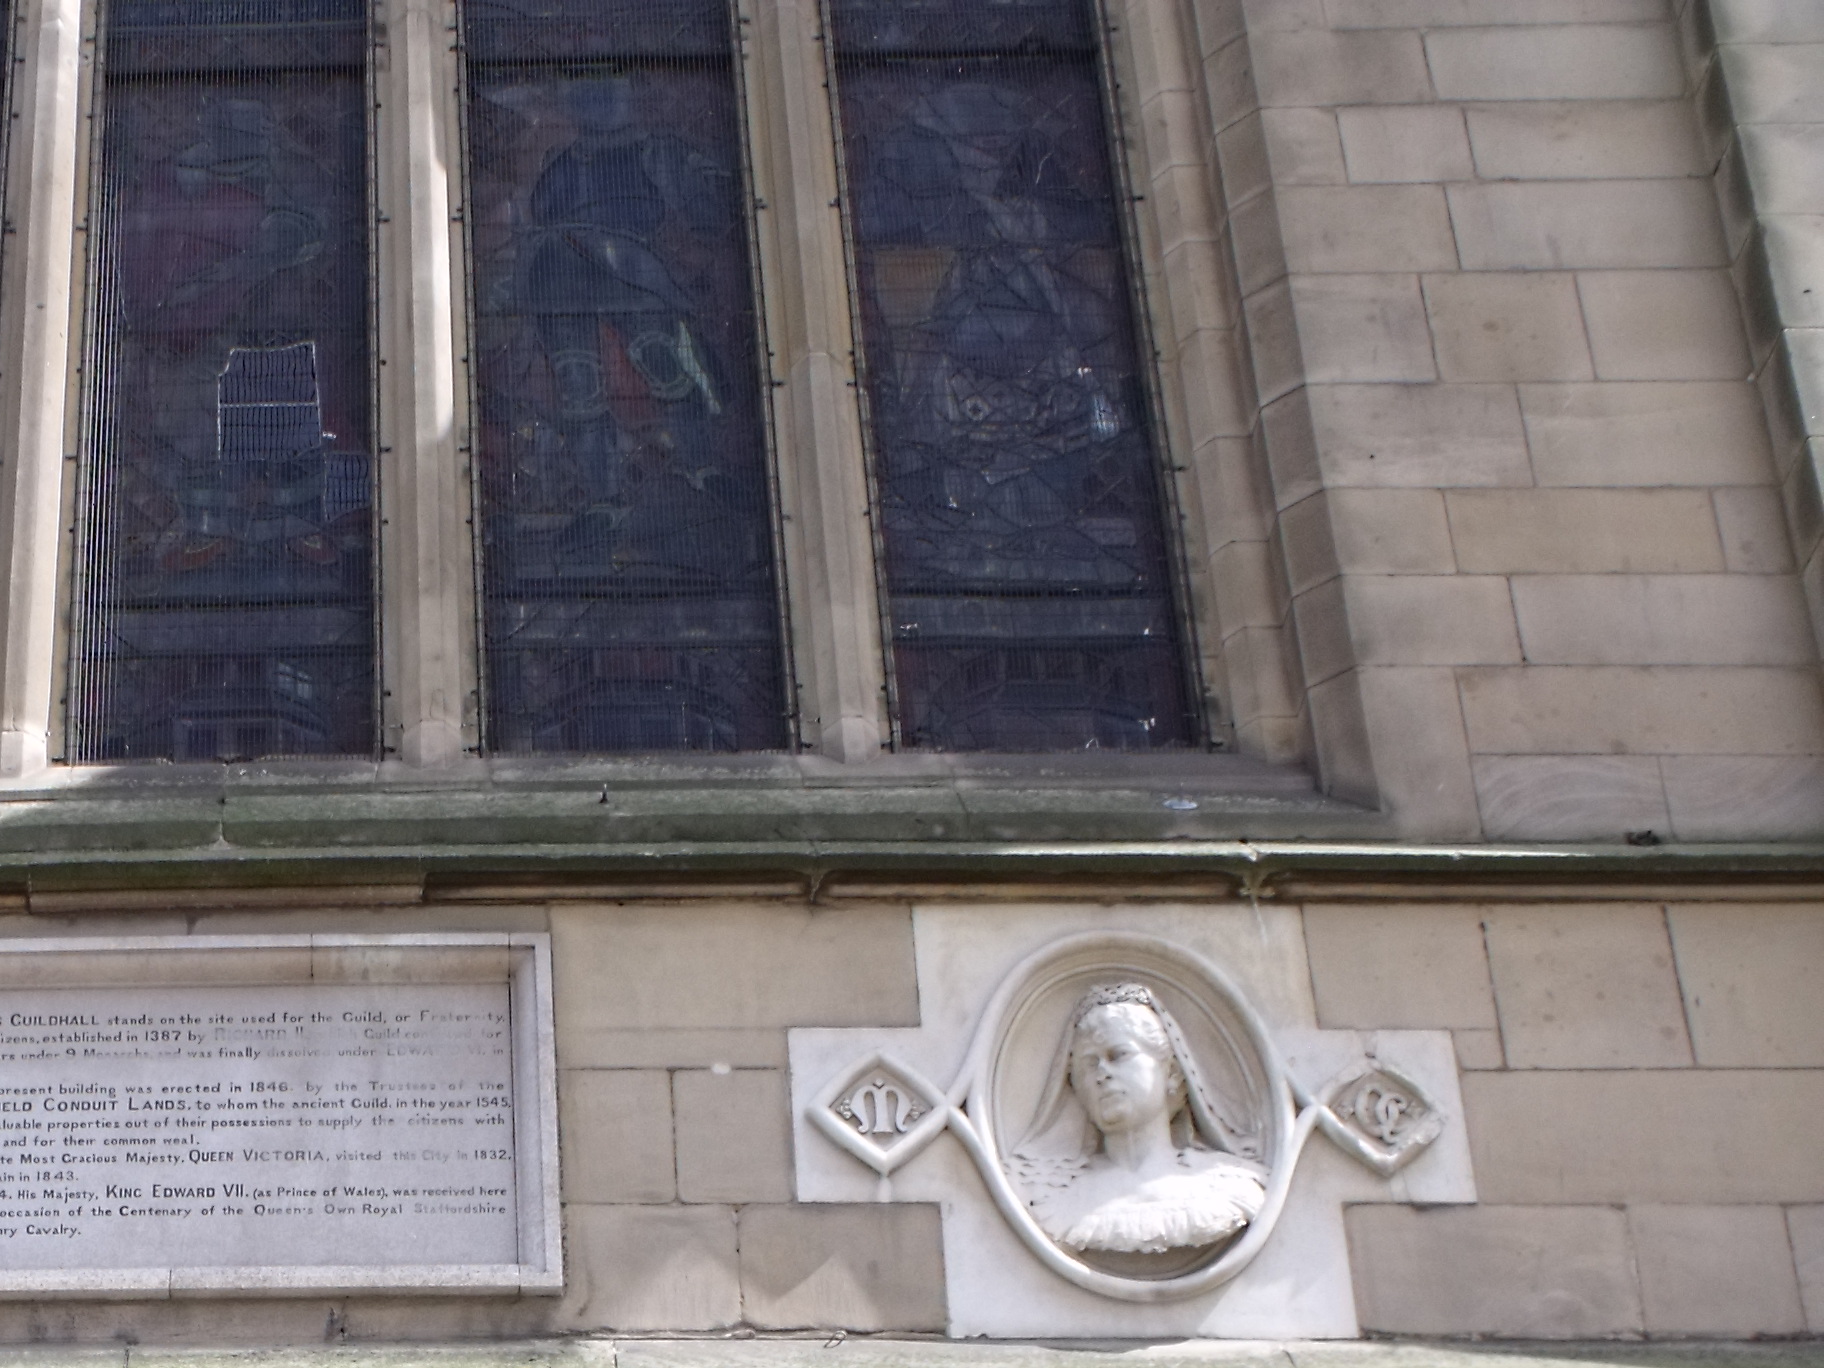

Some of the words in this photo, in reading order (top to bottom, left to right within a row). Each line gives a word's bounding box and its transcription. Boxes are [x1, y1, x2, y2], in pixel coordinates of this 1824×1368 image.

[10, 1014, 99, 1026] GUILDHALL
[107, 1015, 154, 1025] stands
[160, 1016, 176, 1025] on
[179, 1015, 201, 1025] the
[208, 1014, 233, 1024] site
[242, 1013, 276, 1024] used
[282, 1013, 303, 1023] for
[310, 1012, 333, 1023] the
[395, 1013, 411, 1022] or
[127, 1031, 138, 1042] in
[145, 1030, 181, 1042] 1387
[187, 1030, 205, 1045] by
[364, 1028, 400, 1039] Guild
[21, 1050, 60, 1060] under
[66, 1048, 76, 1059] 9
[187, 1050, 212, 1058] was
[219, 1047, 261, 1060] finally
[338, 1046, 376, 1056] under
[492, 1046, 504, 1055] in
[59, 1084, 116, 1098] building
[125, 1085, 152, 1094] was
[161, 1083, 221, 1093] erected
[230, 1082, 241, 1093] in
[306, 1082, 323, 1095] by
[335, 1081, 358, 1092] the
[369, 1081, 436, 1092] Trustees
[448, 1080, 464, 1091] of
[480, 1081, 505, 1091] the
[43, 1098, 119, 1111] CONDUIT
[197, 1101, 211, 1111] to
[217, 1098, 258, 1110] whom
[263, 1099, 285, 1109] the
[292, 1098, 344, 1109] ancient
[396, 1097, 407, 1108] in
[412, 1097, 435, 1108] the
[439, 1099, 471, 1110] year
[47, 1119, 119, 1131] properties
[125, 1119, 148, 1129] out
[154, 1118, 170, 1128] of
[177, 1118, 207, 1128] their
[211, 1116, 292, 1129] possessions
[299, 1117, 313, 1127] to
[318, 1117, 362, 1130] supply
[371, 1115, 395, 1126] the
[407, 1114, 464, 1126] citizens
[475, 1114, 505, 1126] with
[3, 1135, 26, 1147] and
[33, 1135, 56, 1146] for
[63, 1135, 96, 1146] their
[104, 1136, 156, 1146] common
[163, 1135, 200, 1145] weal.
[20, 1153, 56, 1164] Most
[61, 1153, 117, 1164] Gracious
[189, 1150, 234, 1163] QUEEN
[336, 1150, 382, 1161] visited
[393, 1150, 416, 1160] this
[422, 1149, 449, 1163] City
[456, 1150, 468, 1160] in
[20, 1171, 30, 1182] in
[36, 1170, 79, 1182] 1843.
[18, 1189, 36, 1200] His
[106, 1185, 142, 1199] KING
[152, 1184, 215, 1199] EDWARD
[252, 1187, 271, 1200] (as
[277, 1187, 317, 1197] Prince
[323, 1186, 337, 1197] of
[393, 1188, 418, 1197] was
[422, 1186, 475, 1197] received
[480, 1186, 507, 1196] here
[0, 1207, 60, 1218] occasion
[68, 1206, 83, 1217] of
[91, 1206, 112, 1217] the
[119, 1205, 191, 1218] Centenary
[201, 1205, 215, 1215] of
[222, 1204, 243, 1215] the
[323, 1203, 355, 1215] Own
[362, 1203, 402, 1218] Royal
[26, 1224, 81, 1238] Cavalry.
